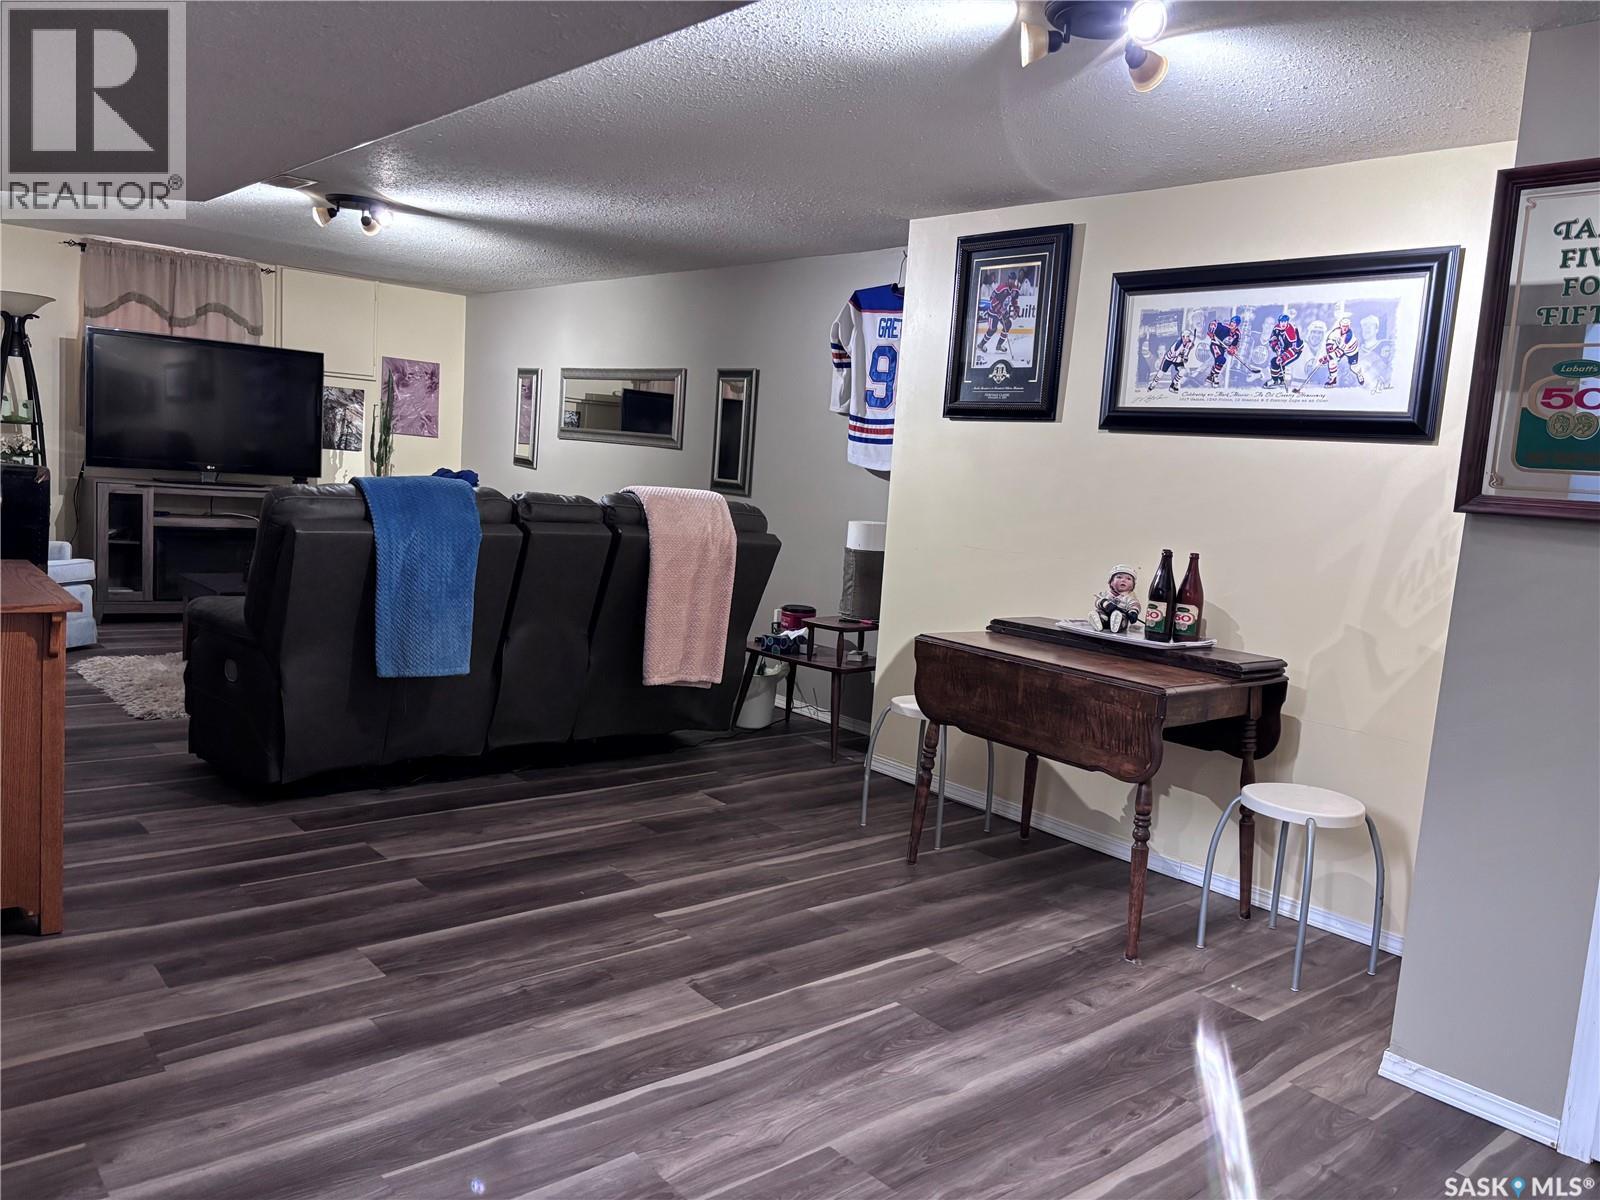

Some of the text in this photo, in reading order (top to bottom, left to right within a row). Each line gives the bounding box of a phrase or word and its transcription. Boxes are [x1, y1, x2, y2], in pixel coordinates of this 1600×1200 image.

[1553, 217, 1600, 240] TA
[865, 345, 898, 410] 9
[1560, 364, 1599, 373] Labatt's
